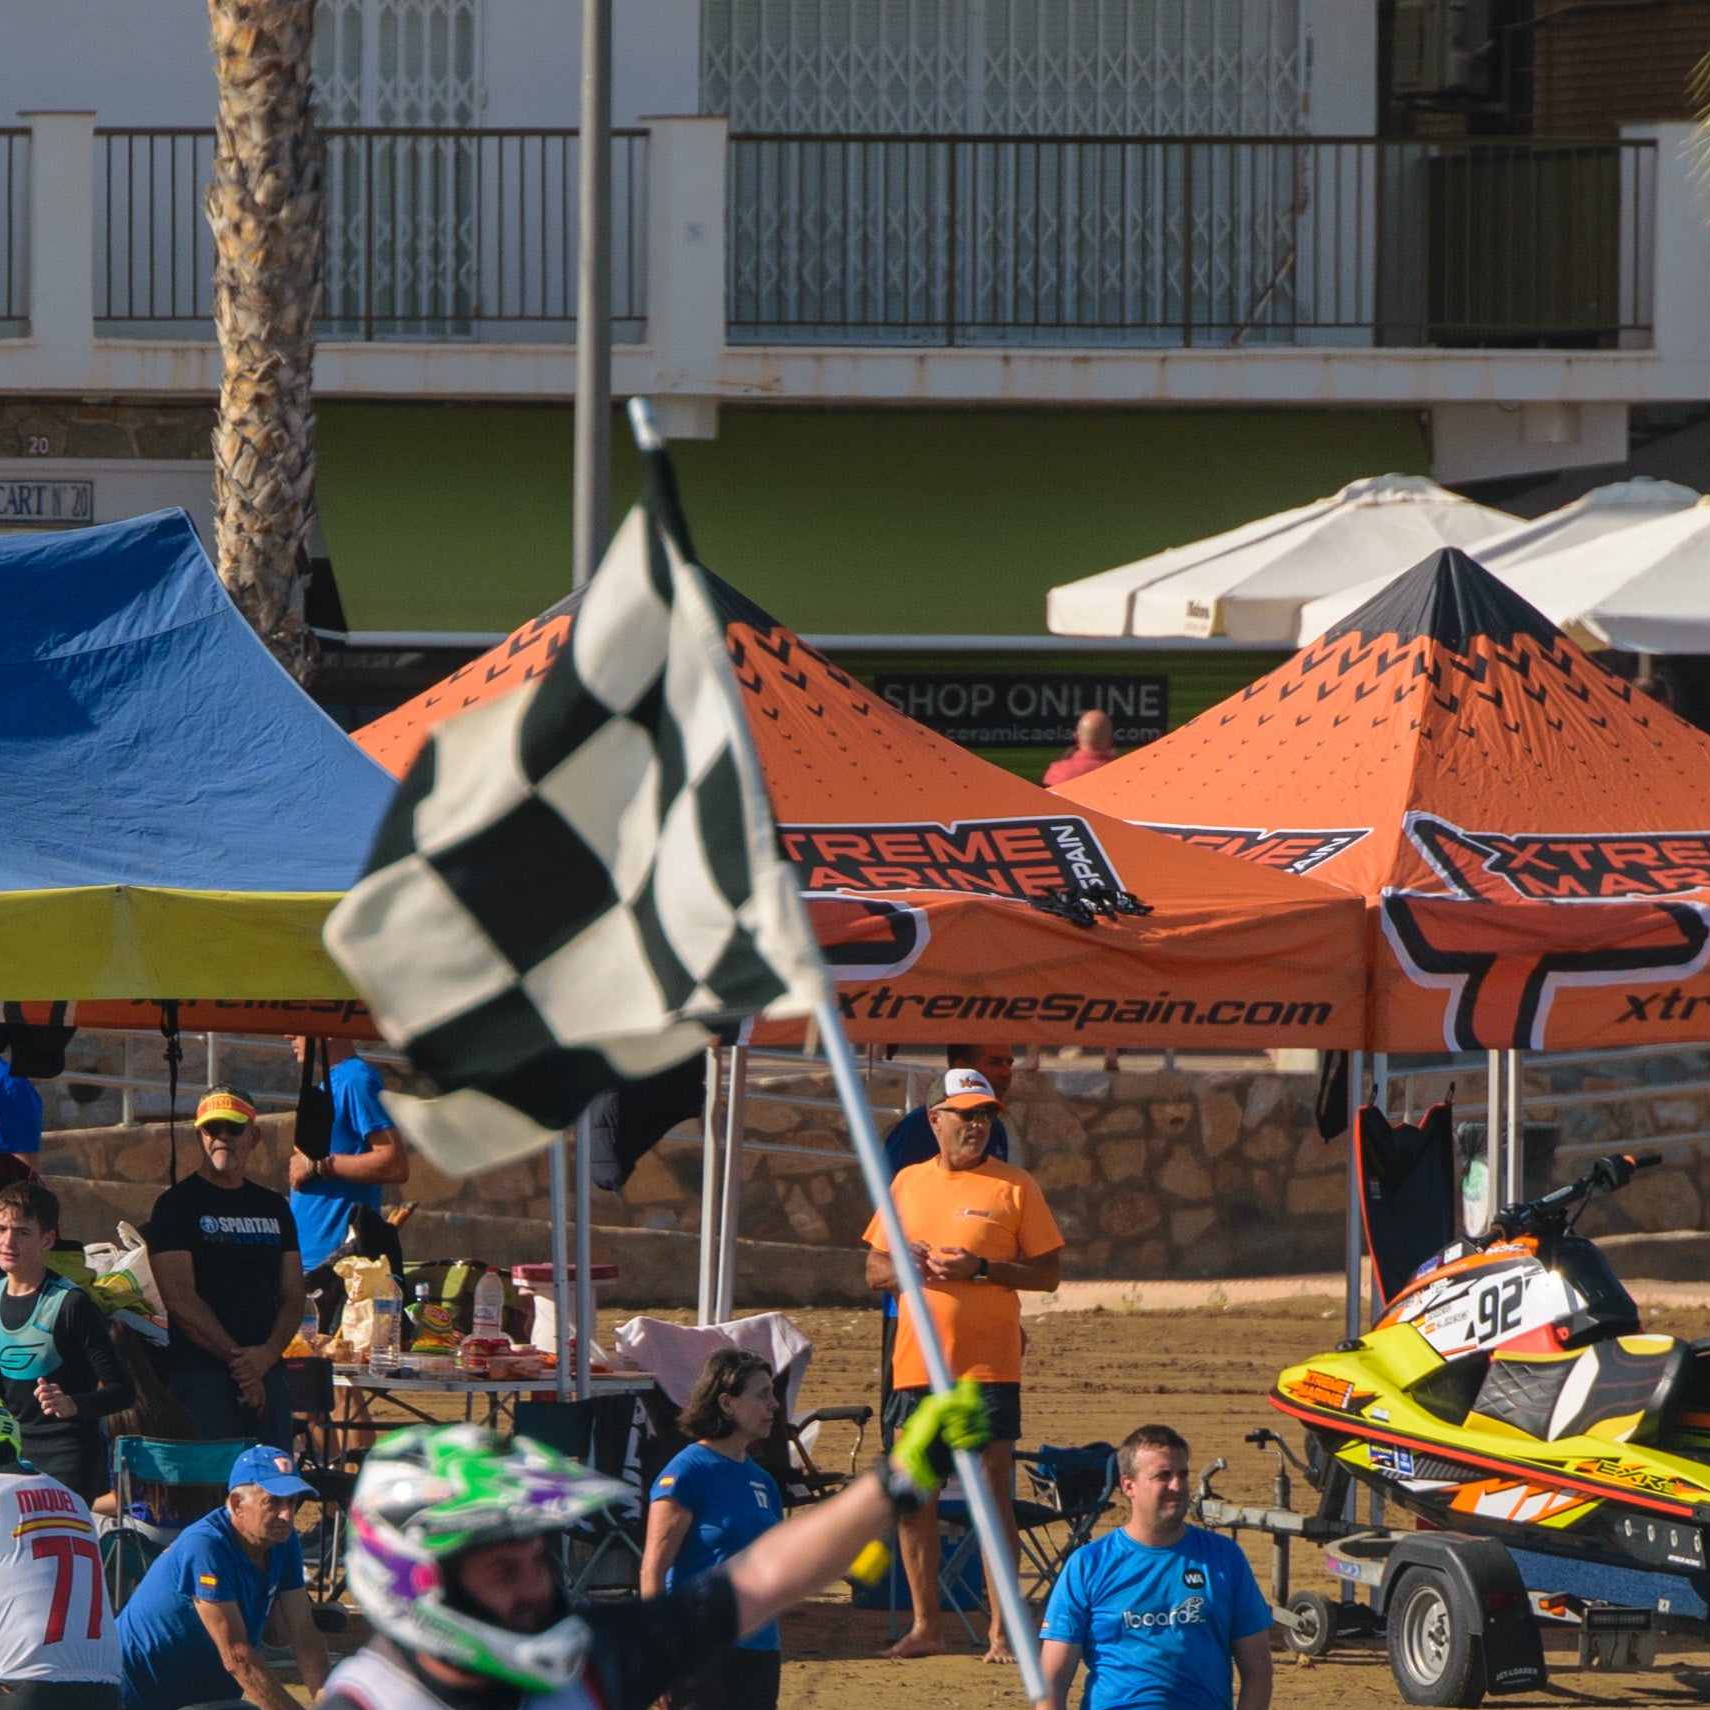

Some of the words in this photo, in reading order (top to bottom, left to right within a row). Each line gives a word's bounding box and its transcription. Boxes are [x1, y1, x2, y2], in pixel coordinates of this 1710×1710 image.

[28, 436, 50, 454] 20
[72, 485, 88, 517] 20
[882, 683, 995, 718] SHOP
[1007, 683, 1161, 717] ONLINE
[777, 826, 1054, 865] TREME
[808, 864, 1070, 898] ARINE
[837, 983, 1333, 1032] xtremeSpain.com
[218, 1216, 281, 1235] SPARTAN
[1477, 1275, 1524, 1346] 92
[14, 1488, 79, 1515] MIQUEL
[31, 1535, 104, 1646] 77
